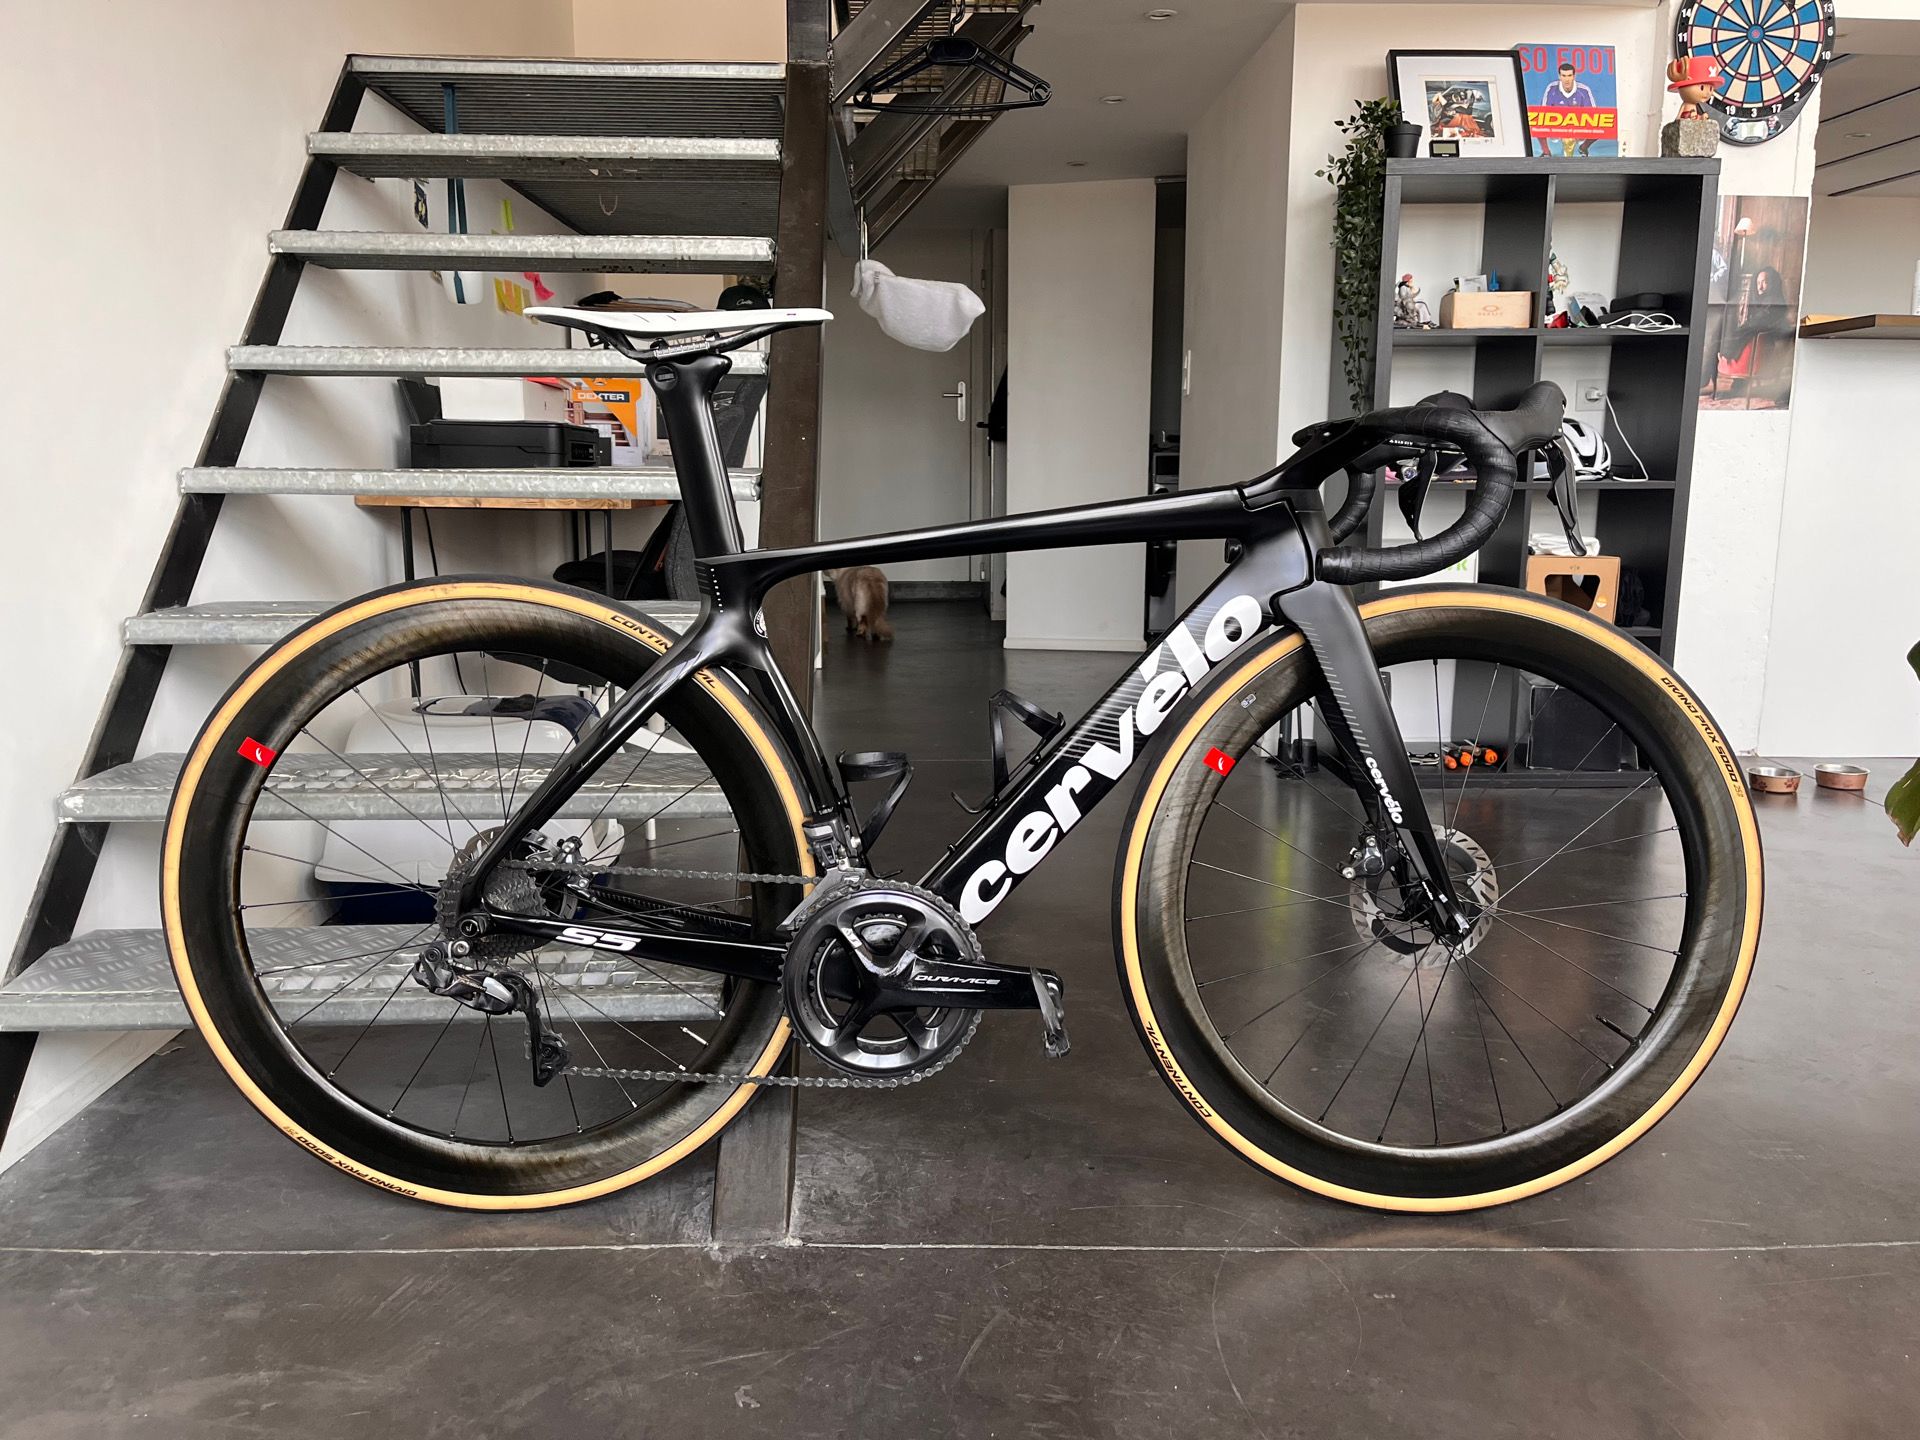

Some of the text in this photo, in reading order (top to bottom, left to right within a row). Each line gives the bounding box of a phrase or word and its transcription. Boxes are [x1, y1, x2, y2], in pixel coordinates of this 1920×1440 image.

[1681, 8, 1692, 18] 14
[1823, 4, 1833, 13] 13
[1827, 26, 1834, 36] 6
[1677, 32, 1688, 42] 11
[1518, 47, 1614, 75] SO FOOT
[1821, 51, 1831, 60] 10
[1809, 73, 1820, 83] 15
[1793, 92, 1800, 101] 2
[1725, 105, 1736, 115] 19
[1750, 108, 1758, 118] 3
[1771, 104, 1782, 114] 17
[1527, 112, 1615, 128] ZIDANE
[577, 392, 625, 401] DEXTER
[1660, 677, 1699, 713] GRAND
[1694, 714, 1720, 744] PRIX
[1715, 745, 1738, 783] 5000
[959, 595, 1263, 925] cervélo
[1365, 756, 1403, 825] cervélo
[555, 927, 642, 951] S5
[914, 973, 1001, 985] DURA-ACE
[1146, 1021, 1212, 1118] CONTINENTAL
[296, 1135, 335, 1161] 5000
[334, 1158, 369, 1179] PRIX
[367, 1176, 418, 1197] GRAND
